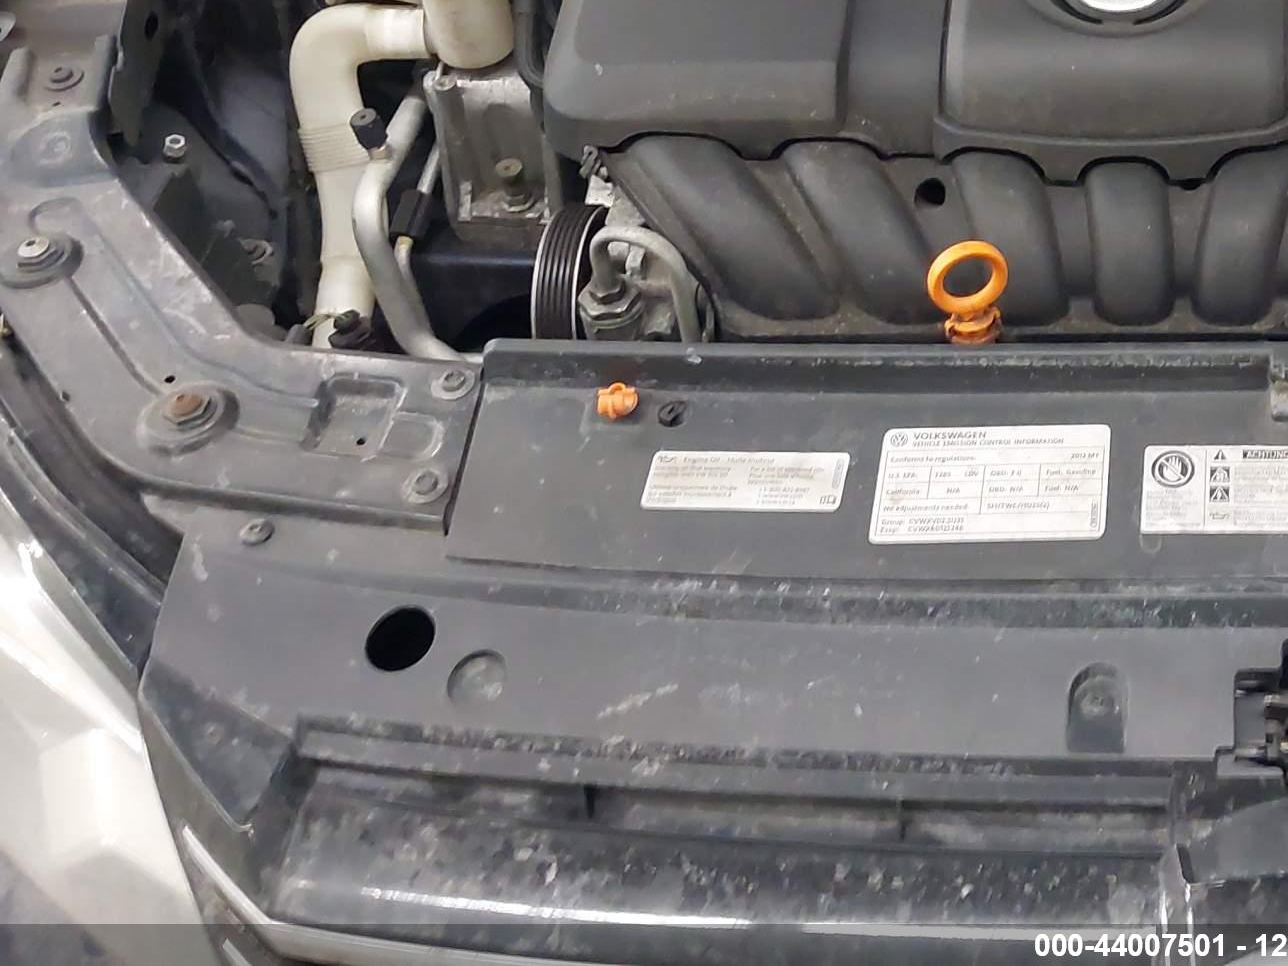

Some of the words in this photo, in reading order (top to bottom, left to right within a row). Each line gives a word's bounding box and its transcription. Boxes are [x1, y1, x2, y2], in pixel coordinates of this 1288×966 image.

[913, 431, 987, 440] VOLKSWAGEN
[912, 440, 941, 448] VEHICLE
[943, 439, 978, 447] EMISSION
[1014, 437, 1064, 445] INFORMATION
[683, 456, 709, 465] Engine
